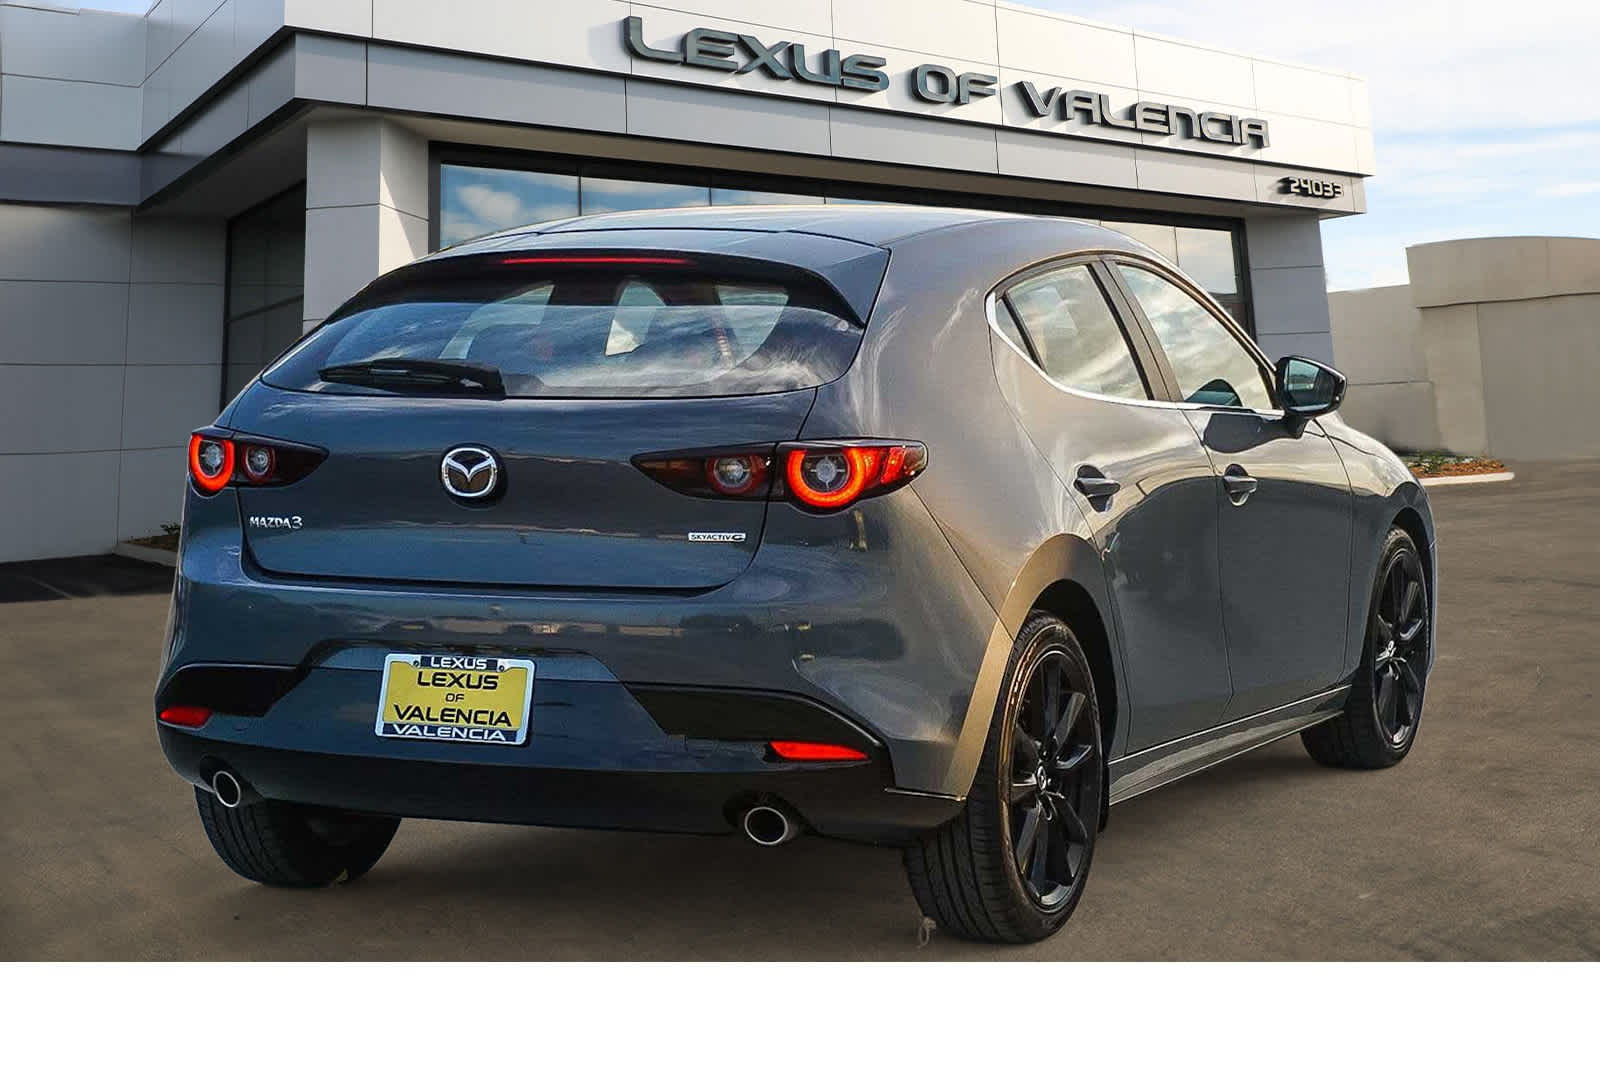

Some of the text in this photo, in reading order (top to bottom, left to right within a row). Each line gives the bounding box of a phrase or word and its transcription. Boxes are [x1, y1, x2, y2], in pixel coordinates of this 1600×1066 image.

[623, 16, 1270, 149] LEXUS OF VALENCIA
[1288, 177, 1344, 197] 24033
[430, 656, 487, 670] LEXUS
[417, 671, 499, 690] LEXUS
[445, 693, 465, 702] OF
[393, 704, 512, 727] VALENCIA
[393, 724, 506, 741] VALENCIA
